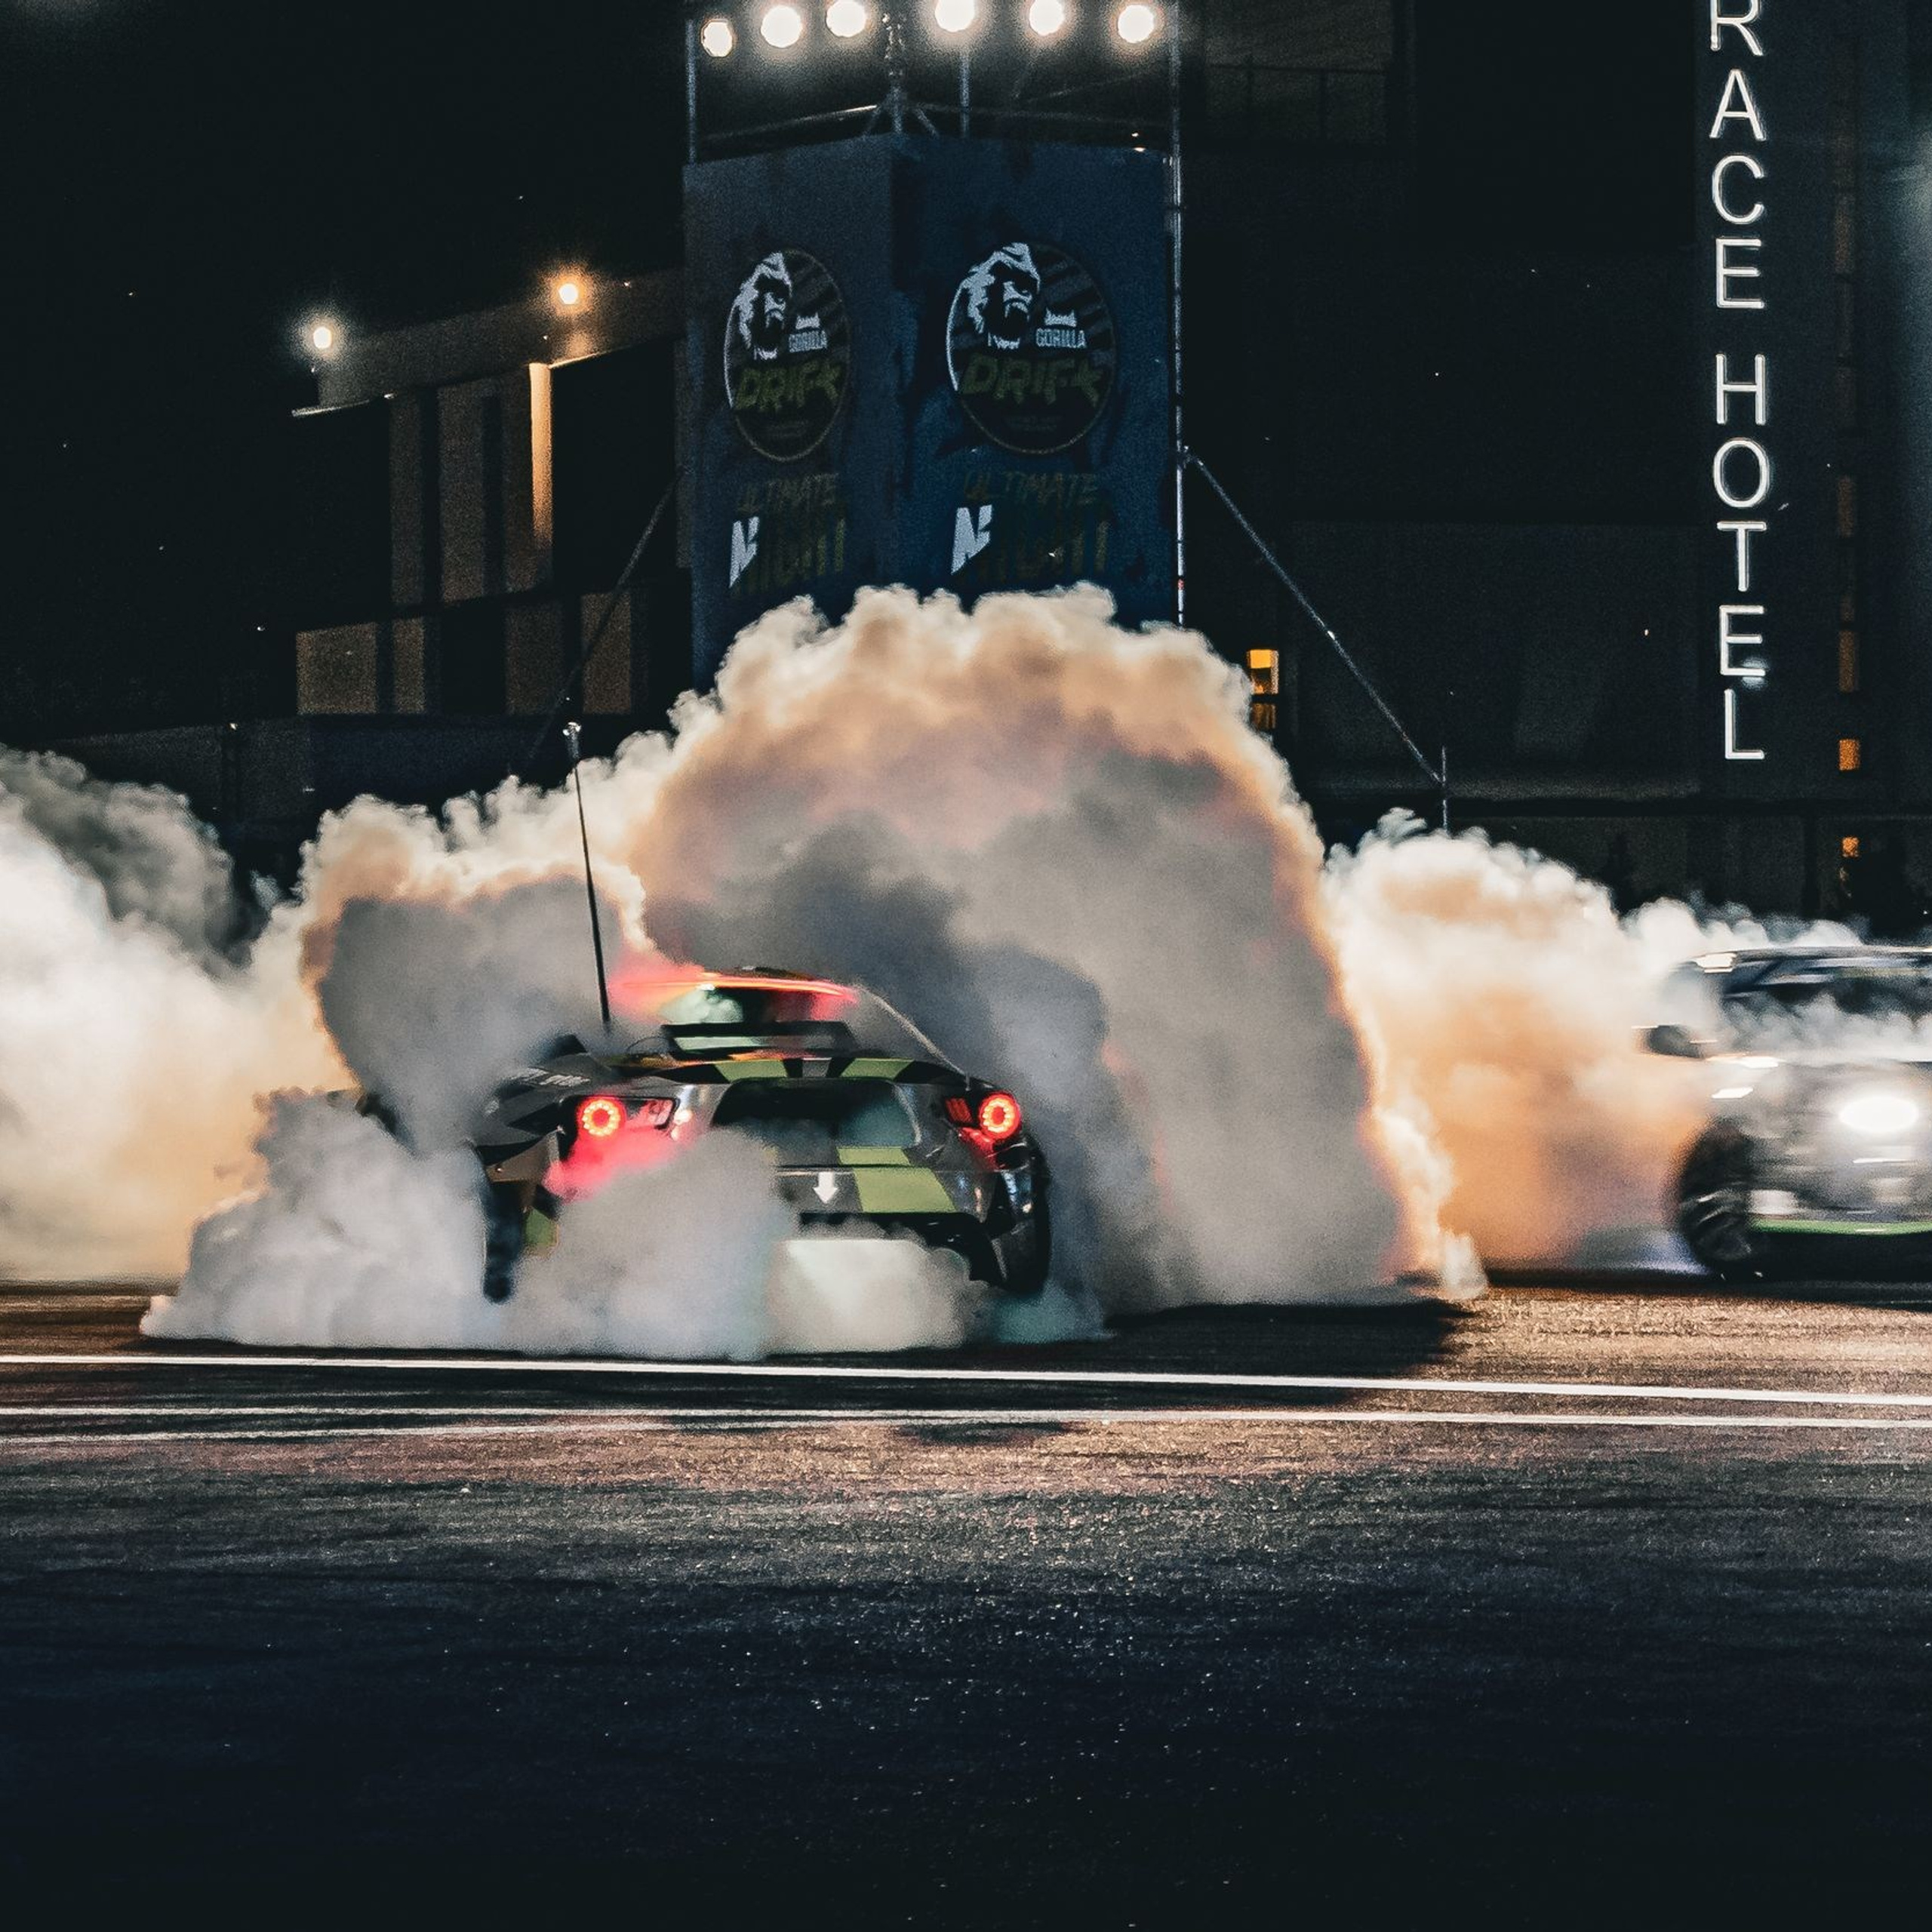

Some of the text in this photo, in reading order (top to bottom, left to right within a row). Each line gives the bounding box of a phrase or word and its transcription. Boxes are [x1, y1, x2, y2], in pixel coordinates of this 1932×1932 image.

[788, 331, 828, 353] GORILLA
[1036, 328, 1088, 349] GORILLA
[1709, 0, 1770, 761] RACE HOTEL
